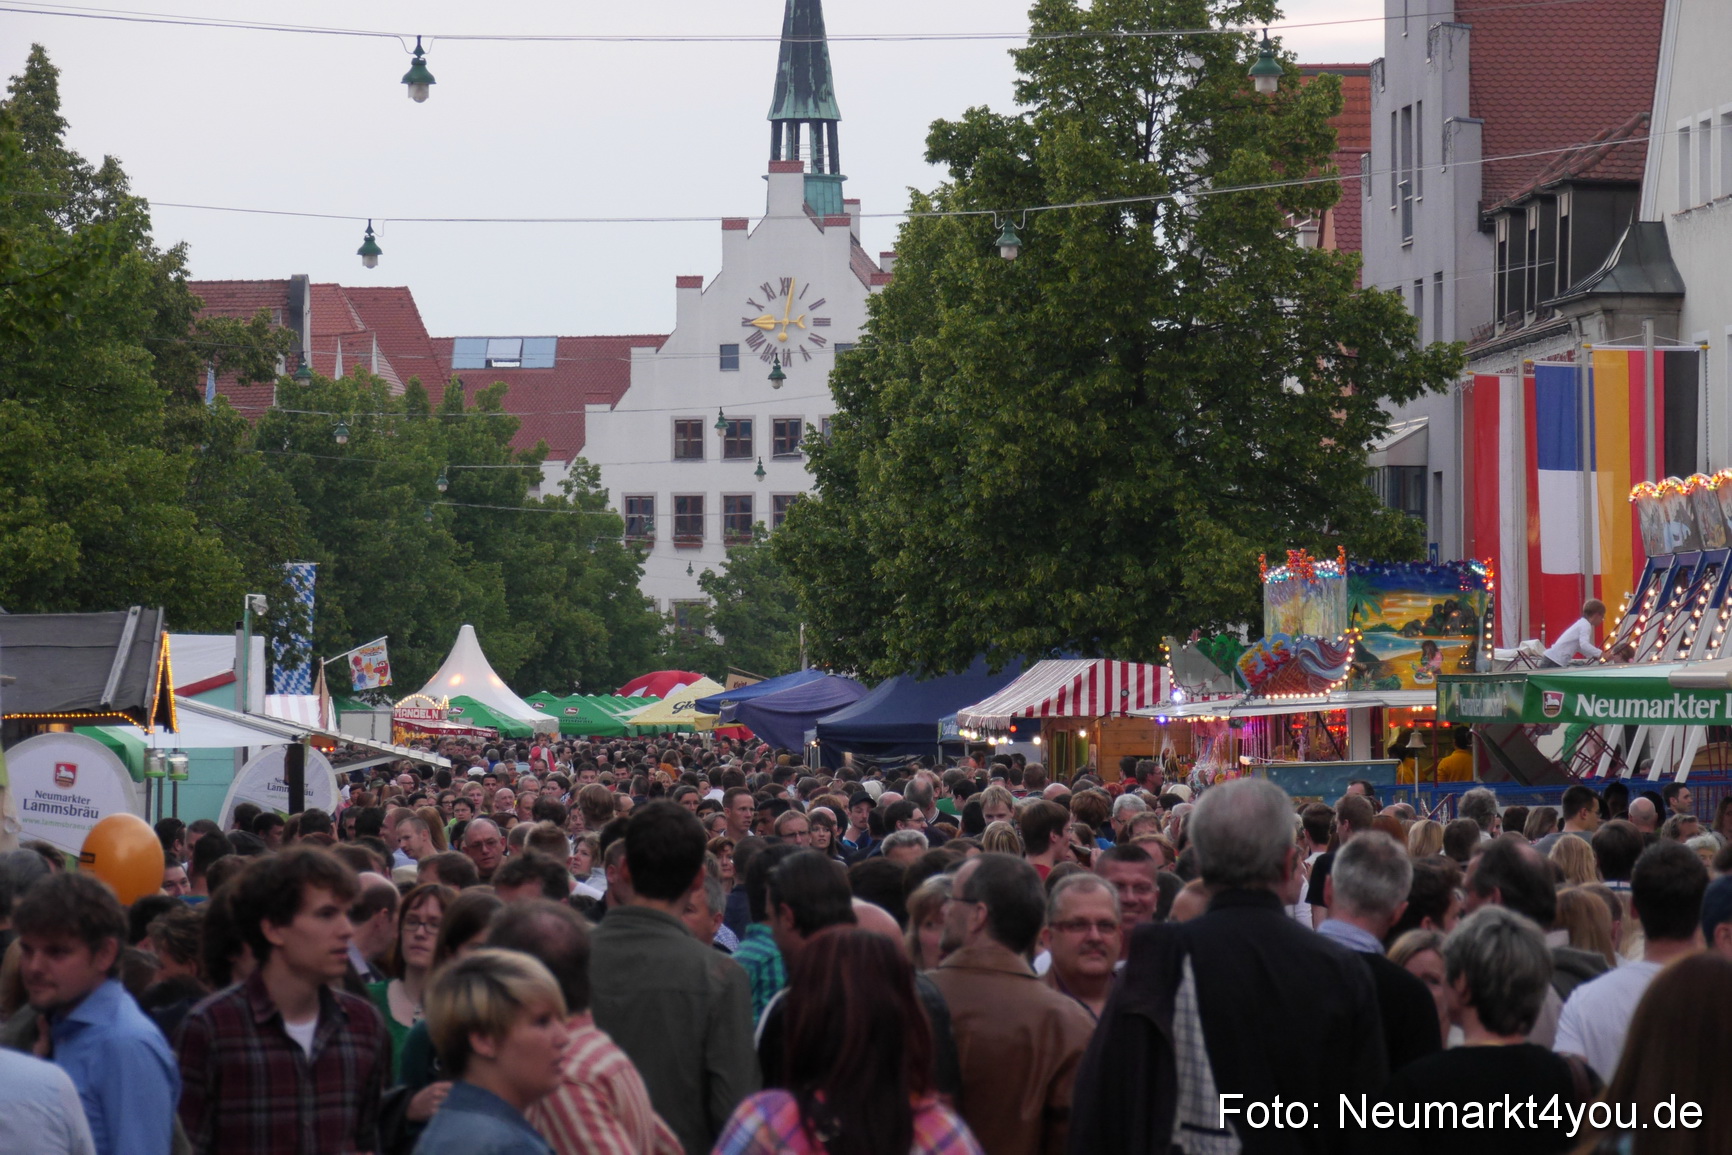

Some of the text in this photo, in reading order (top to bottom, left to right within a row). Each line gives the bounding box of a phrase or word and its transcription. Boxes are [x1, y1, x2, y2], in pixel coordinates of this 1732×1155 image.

[812, 317, 831, 327] III
[1574, 692, 1721, 719] Neumarkter
[34, 789, 92, 805] Neumarkter
[22, 798, 99, 819] Lammsbräu
